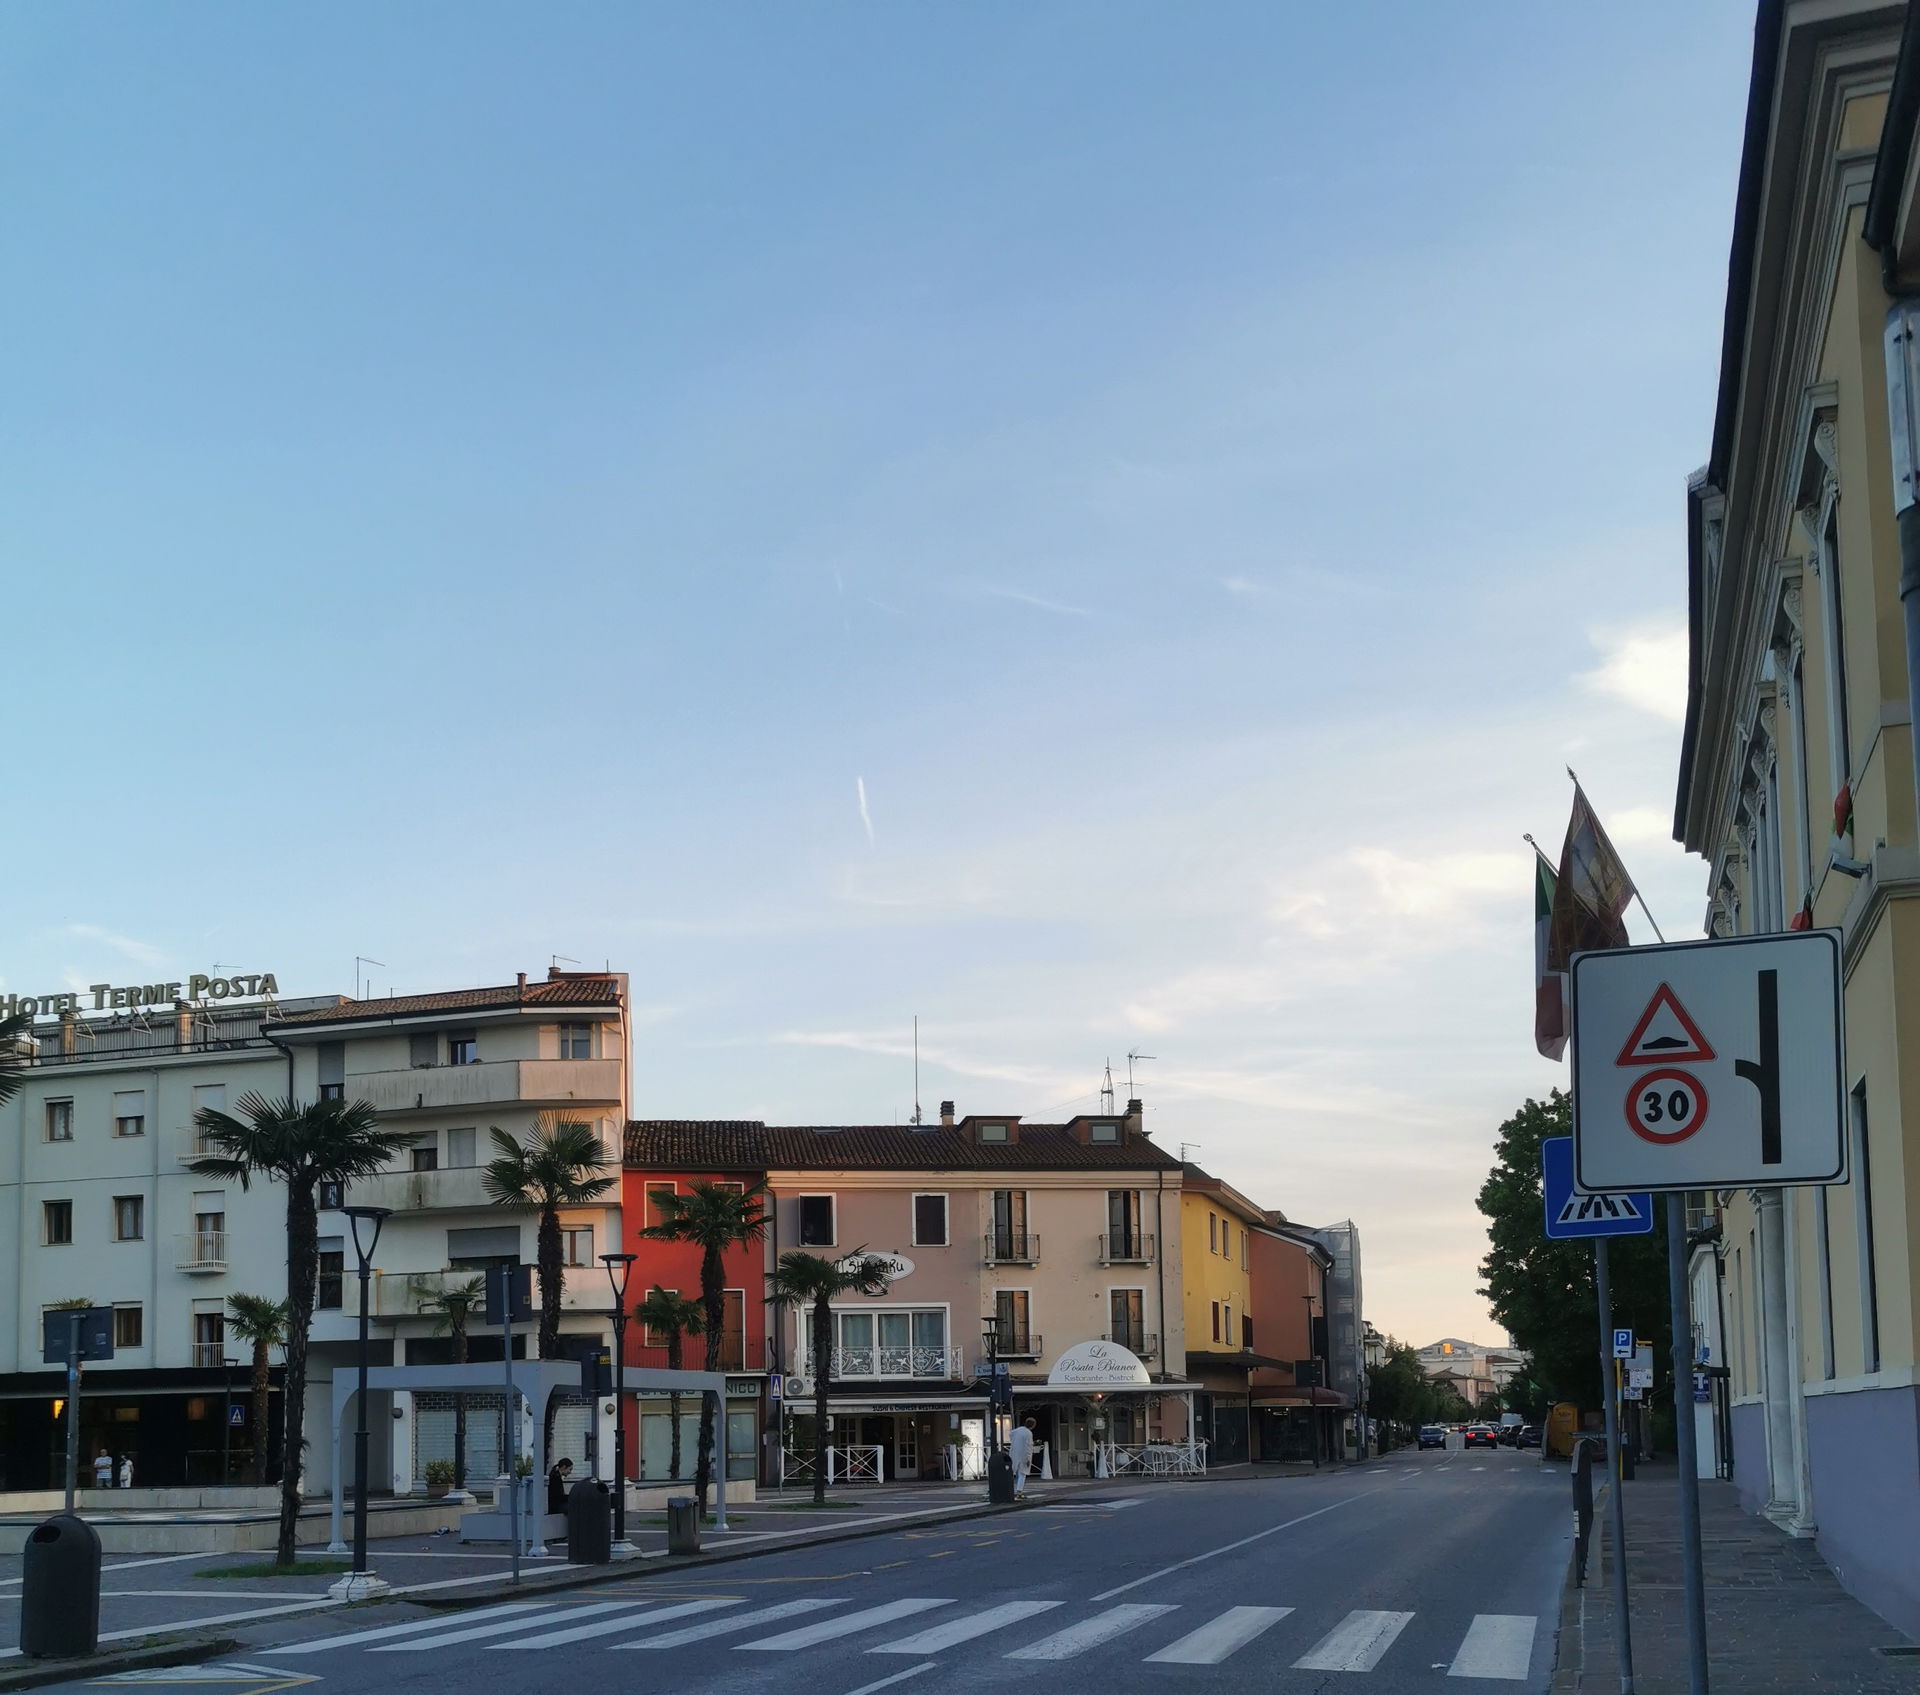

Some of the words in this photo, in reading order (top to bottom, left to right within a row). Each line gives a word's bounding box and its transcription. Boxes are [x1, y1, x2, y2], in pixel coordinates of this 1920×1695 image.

[0, 992, 82, 1018] HOTEL
[89, 983, 181, 1010] TERME
[188, 973, 279, 1001] POSTA
[1644, 1090, 1689, 1122] 30
[1618, 1333, 1627, 1345] P
[1088, 1344, 1107, 1358] La
[1060, 1359, 1094, 1372] Posata
[1098, 1359, 1136, 1372] Bianca
